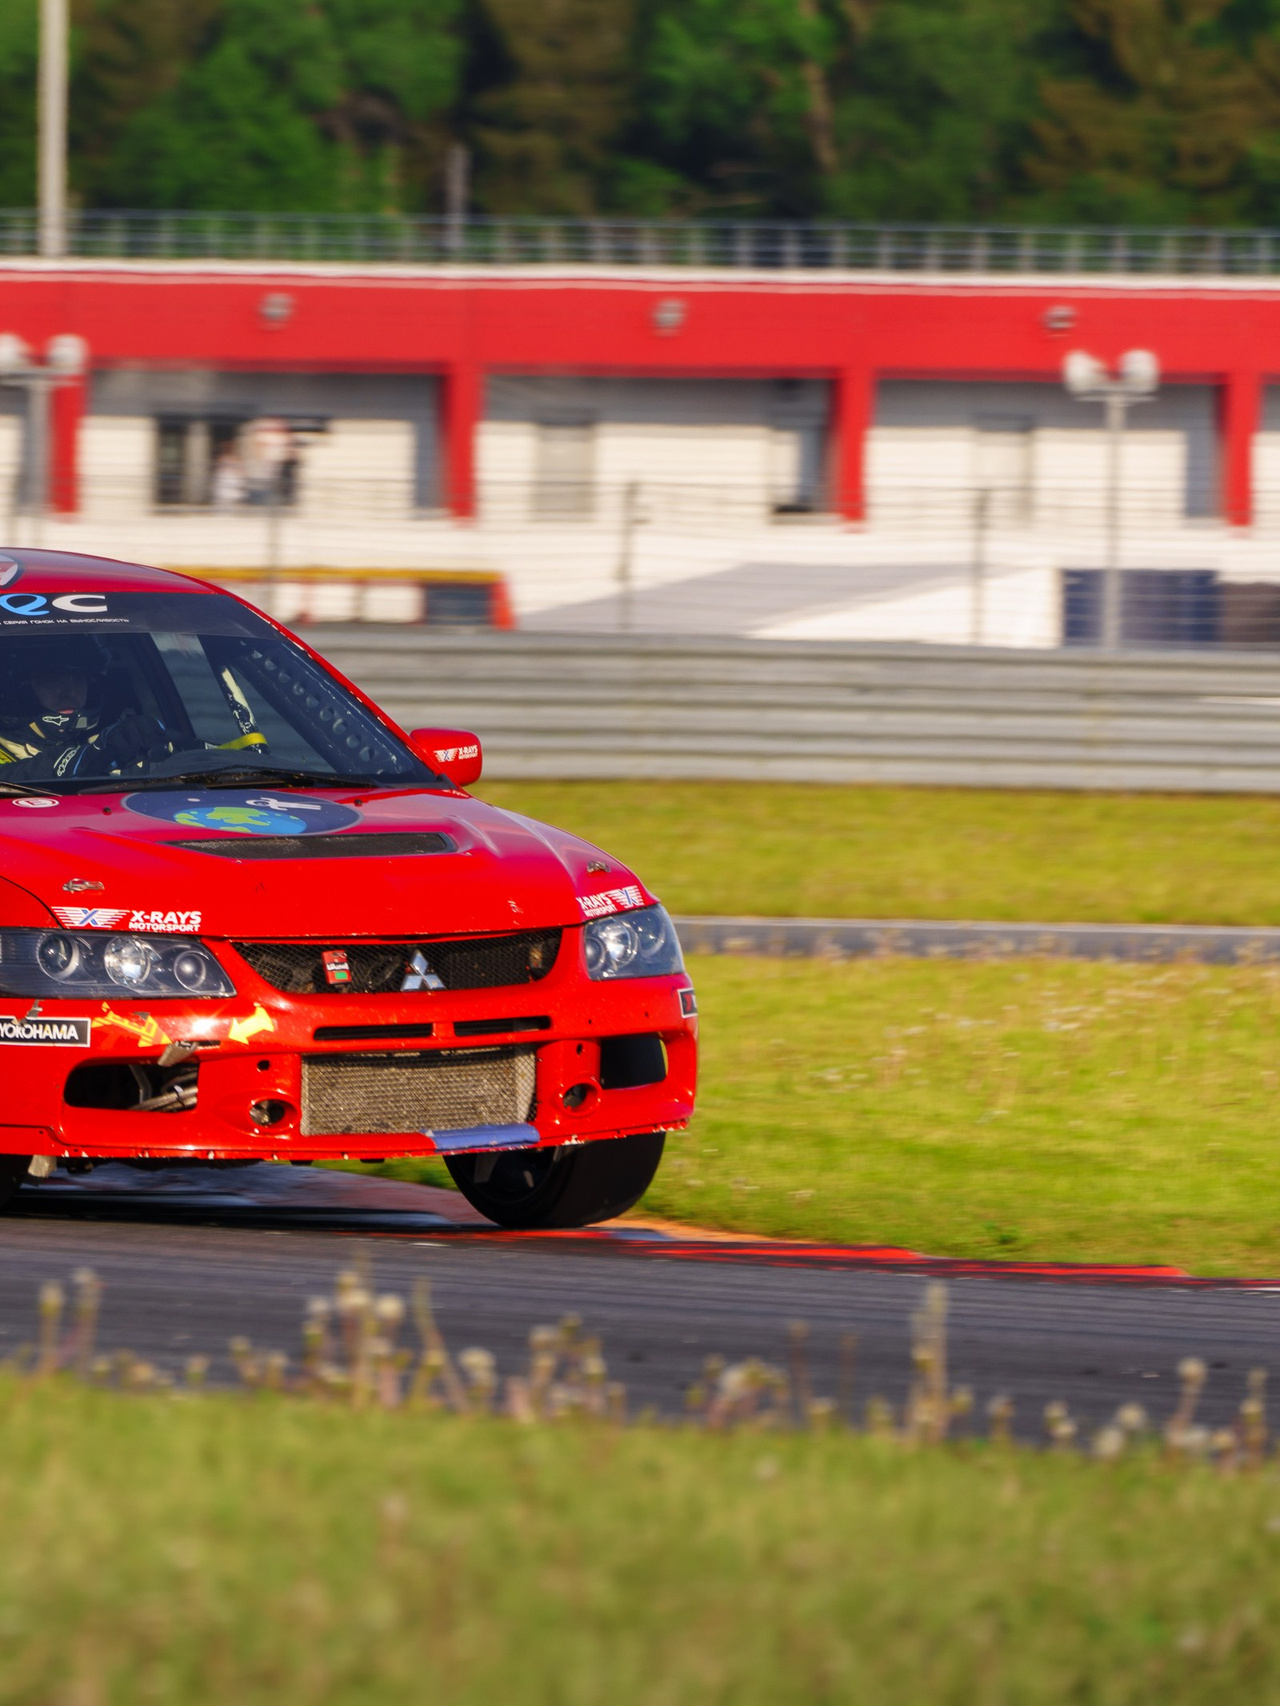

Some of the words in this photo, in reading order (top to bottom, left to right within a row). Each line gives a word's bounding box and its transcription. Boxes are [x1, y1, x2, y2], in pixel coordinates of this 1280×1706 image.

[575, 893, 613, 910] X-RAYS
[129, 910, 202, 924] X-RAYS
[128, 922, 201, 932] MOTORSPORT
